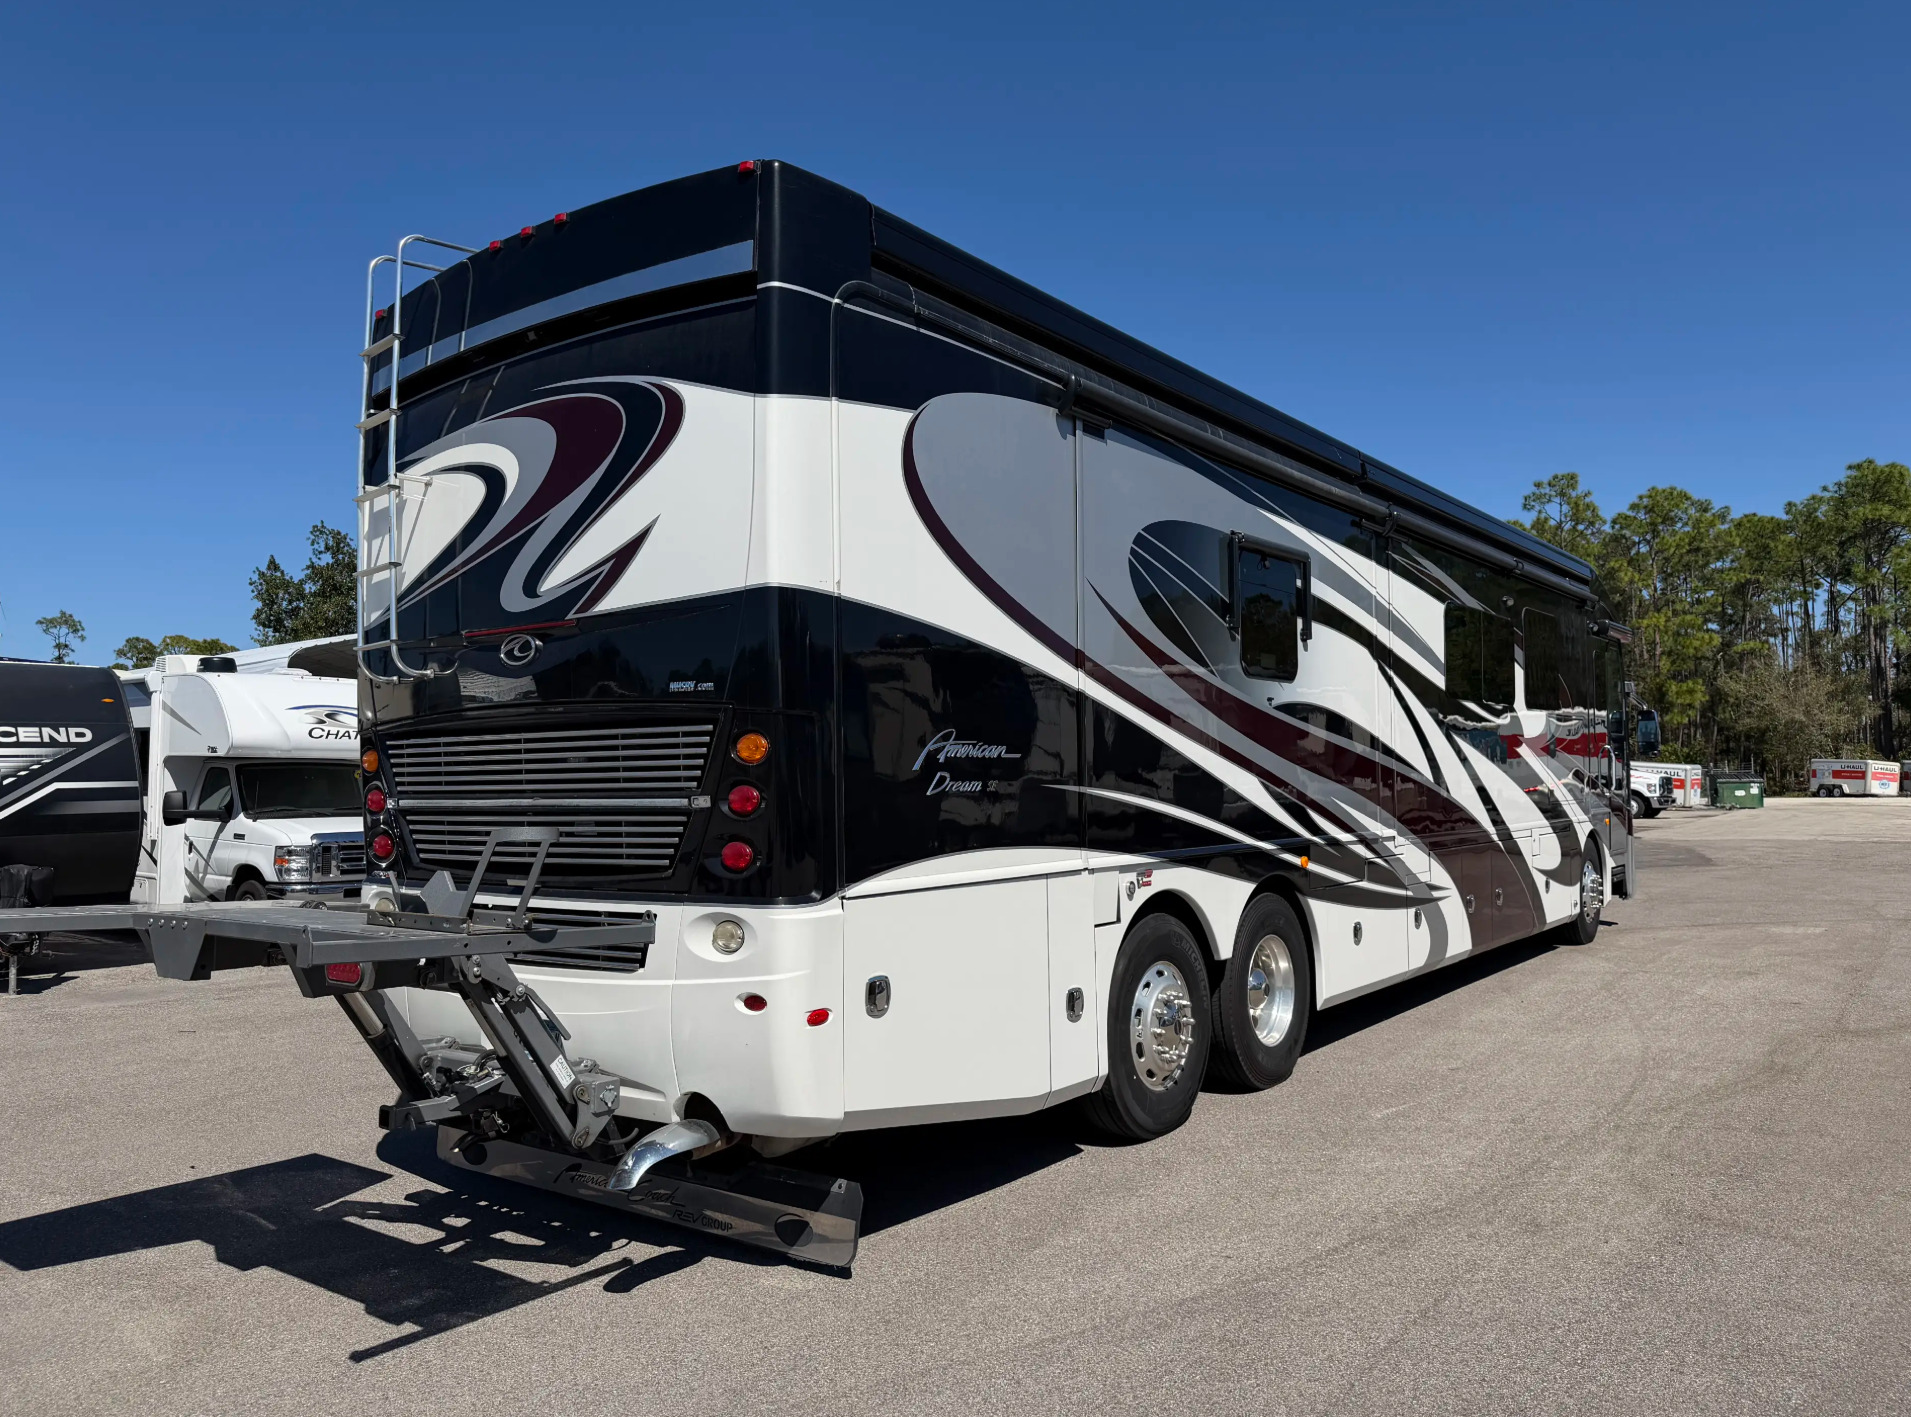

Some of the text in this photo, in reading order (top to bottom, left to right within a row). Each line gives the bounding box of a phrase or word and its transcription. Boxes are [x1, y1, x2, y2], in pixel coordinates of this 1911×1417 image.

[0, 726, 93, 743] CEND
[912, 728, 1022, 771] American
[926, 771, 983, 796] Dream
[553, 1162, 686, 1208] Americ Coach
[701, 1215, 733, 1233] GROUP
